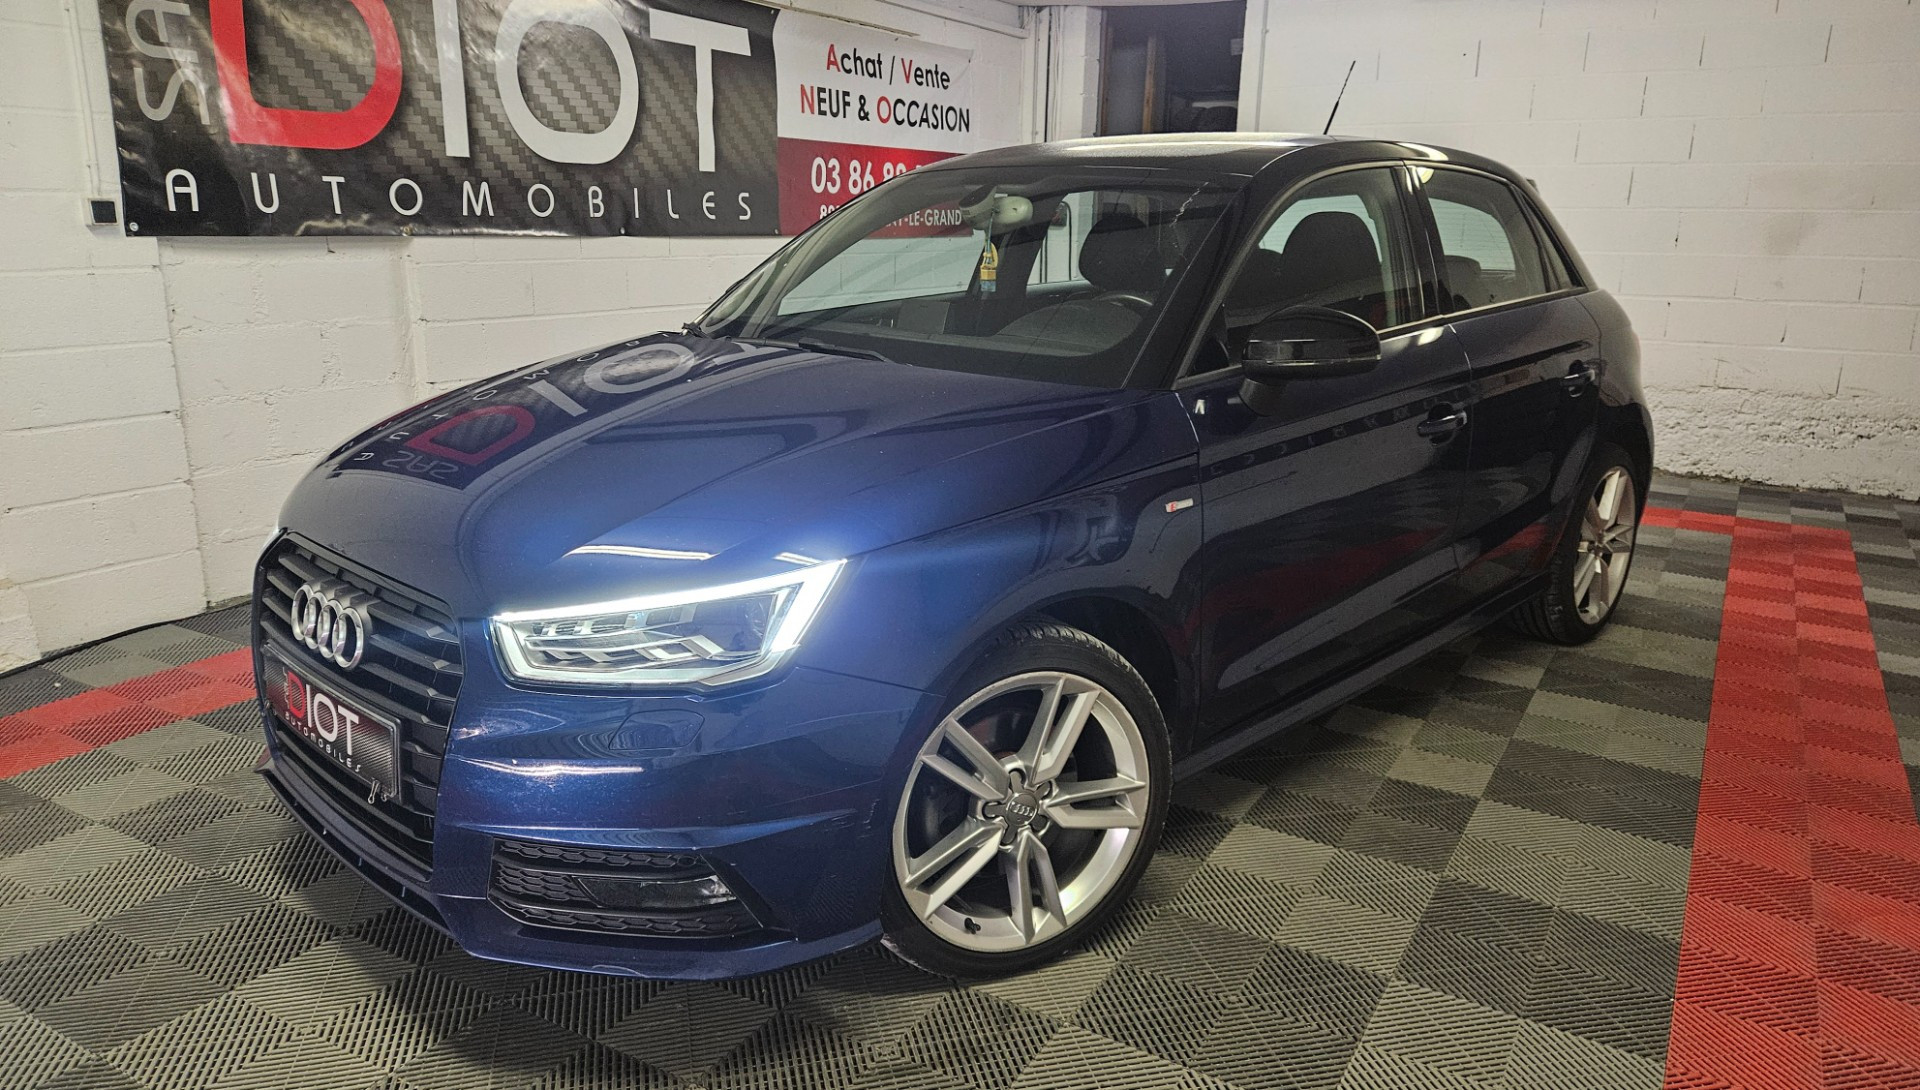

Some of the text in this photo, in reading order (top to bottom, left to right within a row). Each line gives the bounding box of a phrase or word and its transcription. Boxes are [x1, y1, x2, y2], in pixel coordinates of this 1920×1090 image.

[209, 0, 752, 173] DIOT
[826, 44, 883, 79] Achat
[901, 58, 951, 90] Vente
[800, 84, 970, 132] NEUF & OCCASION
[165, 168, 752, 221] AUTOMOBILES
[811, 156, 841, 195] 03
[848, 159, 875, 195] 86
[287, 670, 360, 756] DIOT
